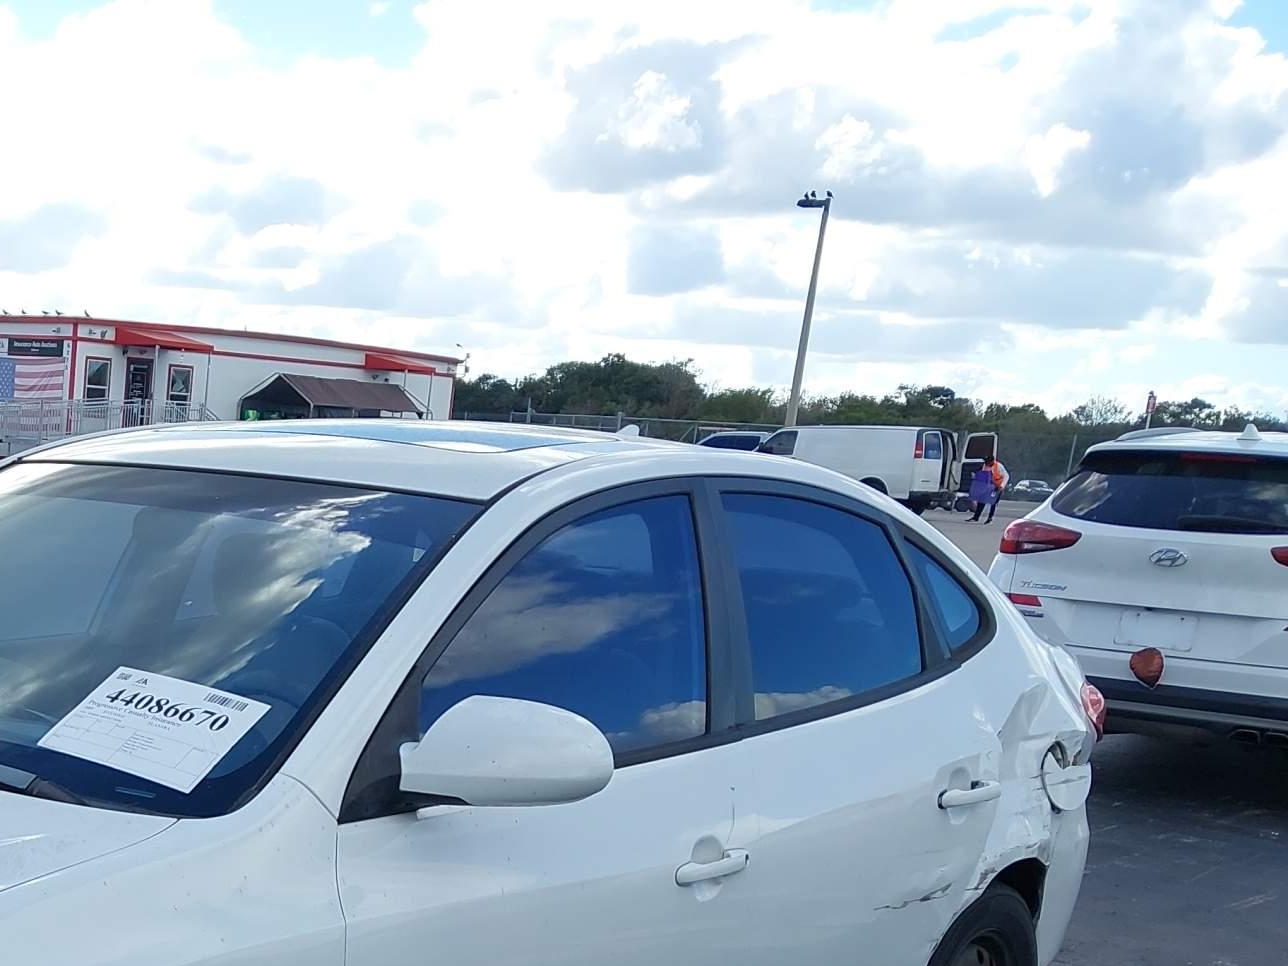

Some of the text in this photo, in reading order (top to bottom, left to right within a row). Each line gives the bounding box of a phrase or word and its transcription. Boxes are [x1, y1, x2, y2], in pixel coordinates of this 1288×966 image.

[88, 699, 124, 713] Progressive
[125, 708, 149, 719] Casualty
[150, 714, 182, 727] Insurance
[106, 688, 229, 731] 44086670
